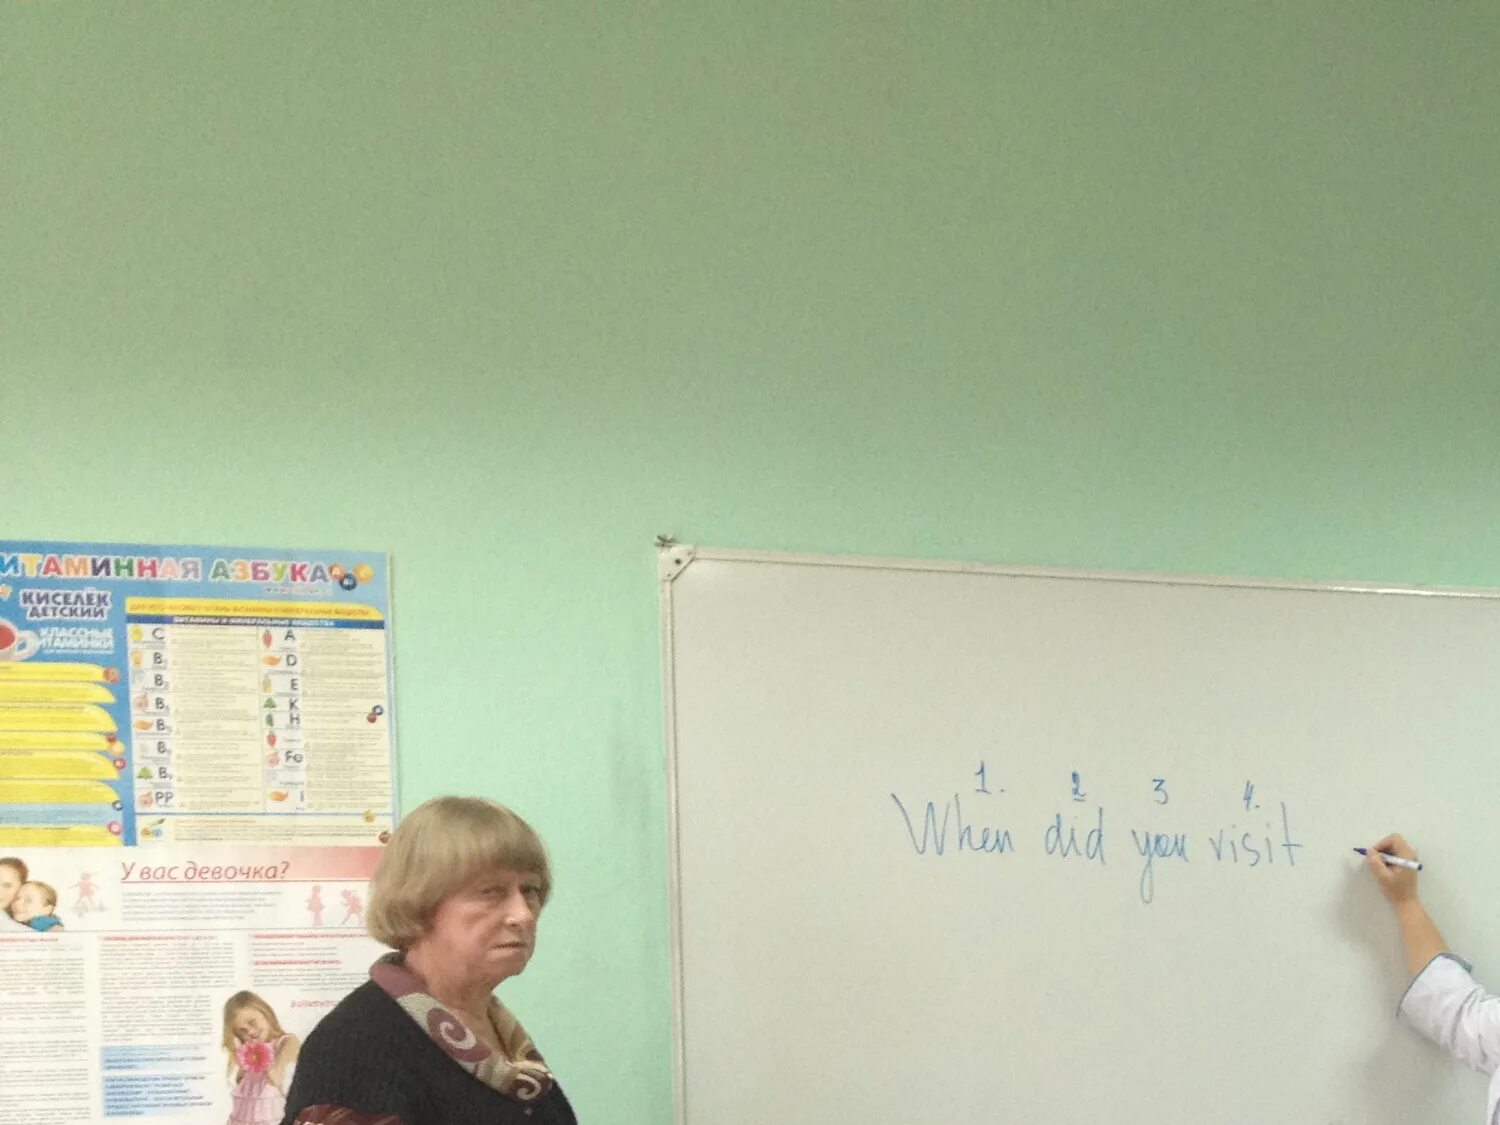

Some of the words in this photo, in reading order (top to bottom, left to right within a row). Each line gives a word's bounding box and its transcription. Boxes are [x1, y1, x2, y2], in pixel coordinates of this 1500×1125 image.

[209, 558, 329, 584] АЗБУКА
[284, 629, 296, 641] A
[286, 654, 297, 666] D
[290, 678, 298, 690] E
[285, 751, 303, 763] Fe
[1152, 779, 1169, 805] 3
[891, 793, 1014, 856] When
[1045, 806, 1106, 866] did
[1131, 828, 1189, 904] you
[1209, 801, 1303, 867] visit
[121, 861, 136, 880] У
[139, 865, 179, 880] вас
[183, 860, 290, 880] девочка?
